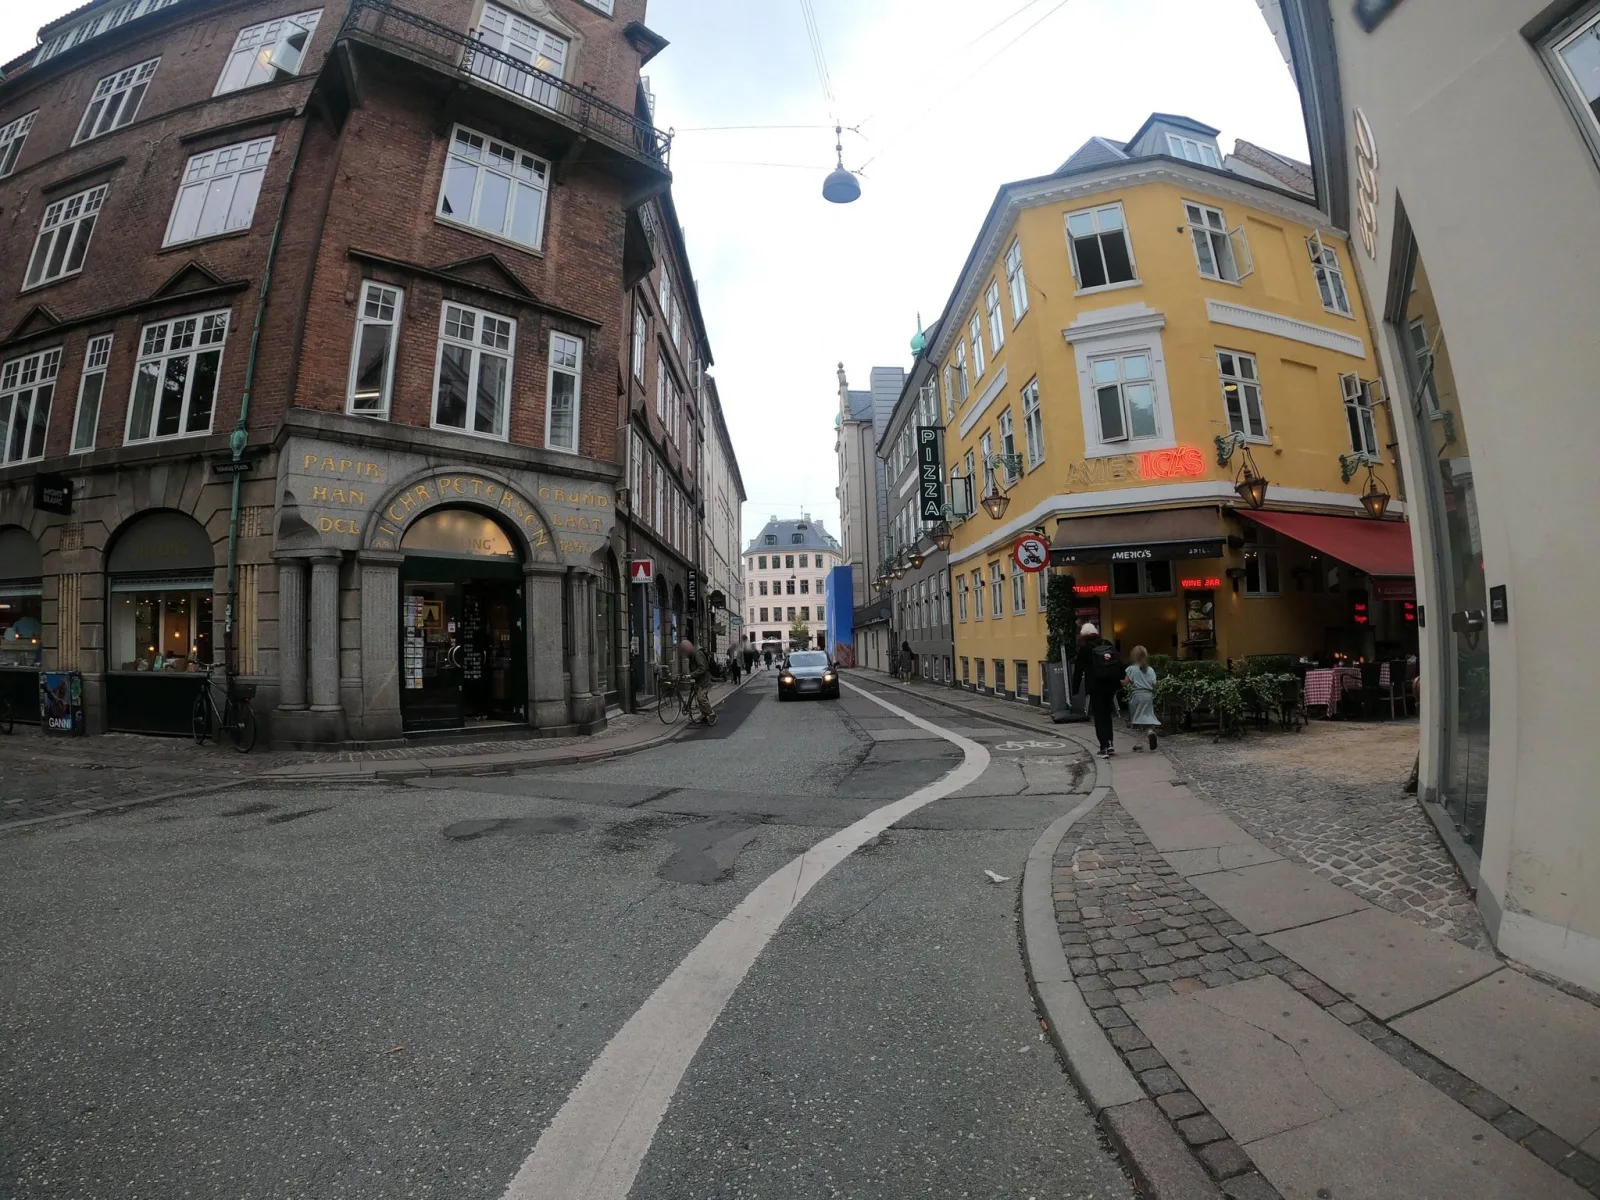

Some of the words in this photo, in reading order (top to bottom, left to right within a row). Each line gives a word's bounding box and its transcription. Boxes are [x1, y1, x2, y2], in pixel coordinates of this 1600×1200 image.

[921, 429, 939, 516] PIZZA
[312, 486, 365, 505] HAN
[538, 487, 608, 508] GRUND
[437, 477, 548, 547] PETERSEN
[319, 516, 360, 536] DEL
[688, 580, 696, 601] KLINT
[1181, 579, 1202, 587] WINE
[48, 717, 72, 729] GANNI
